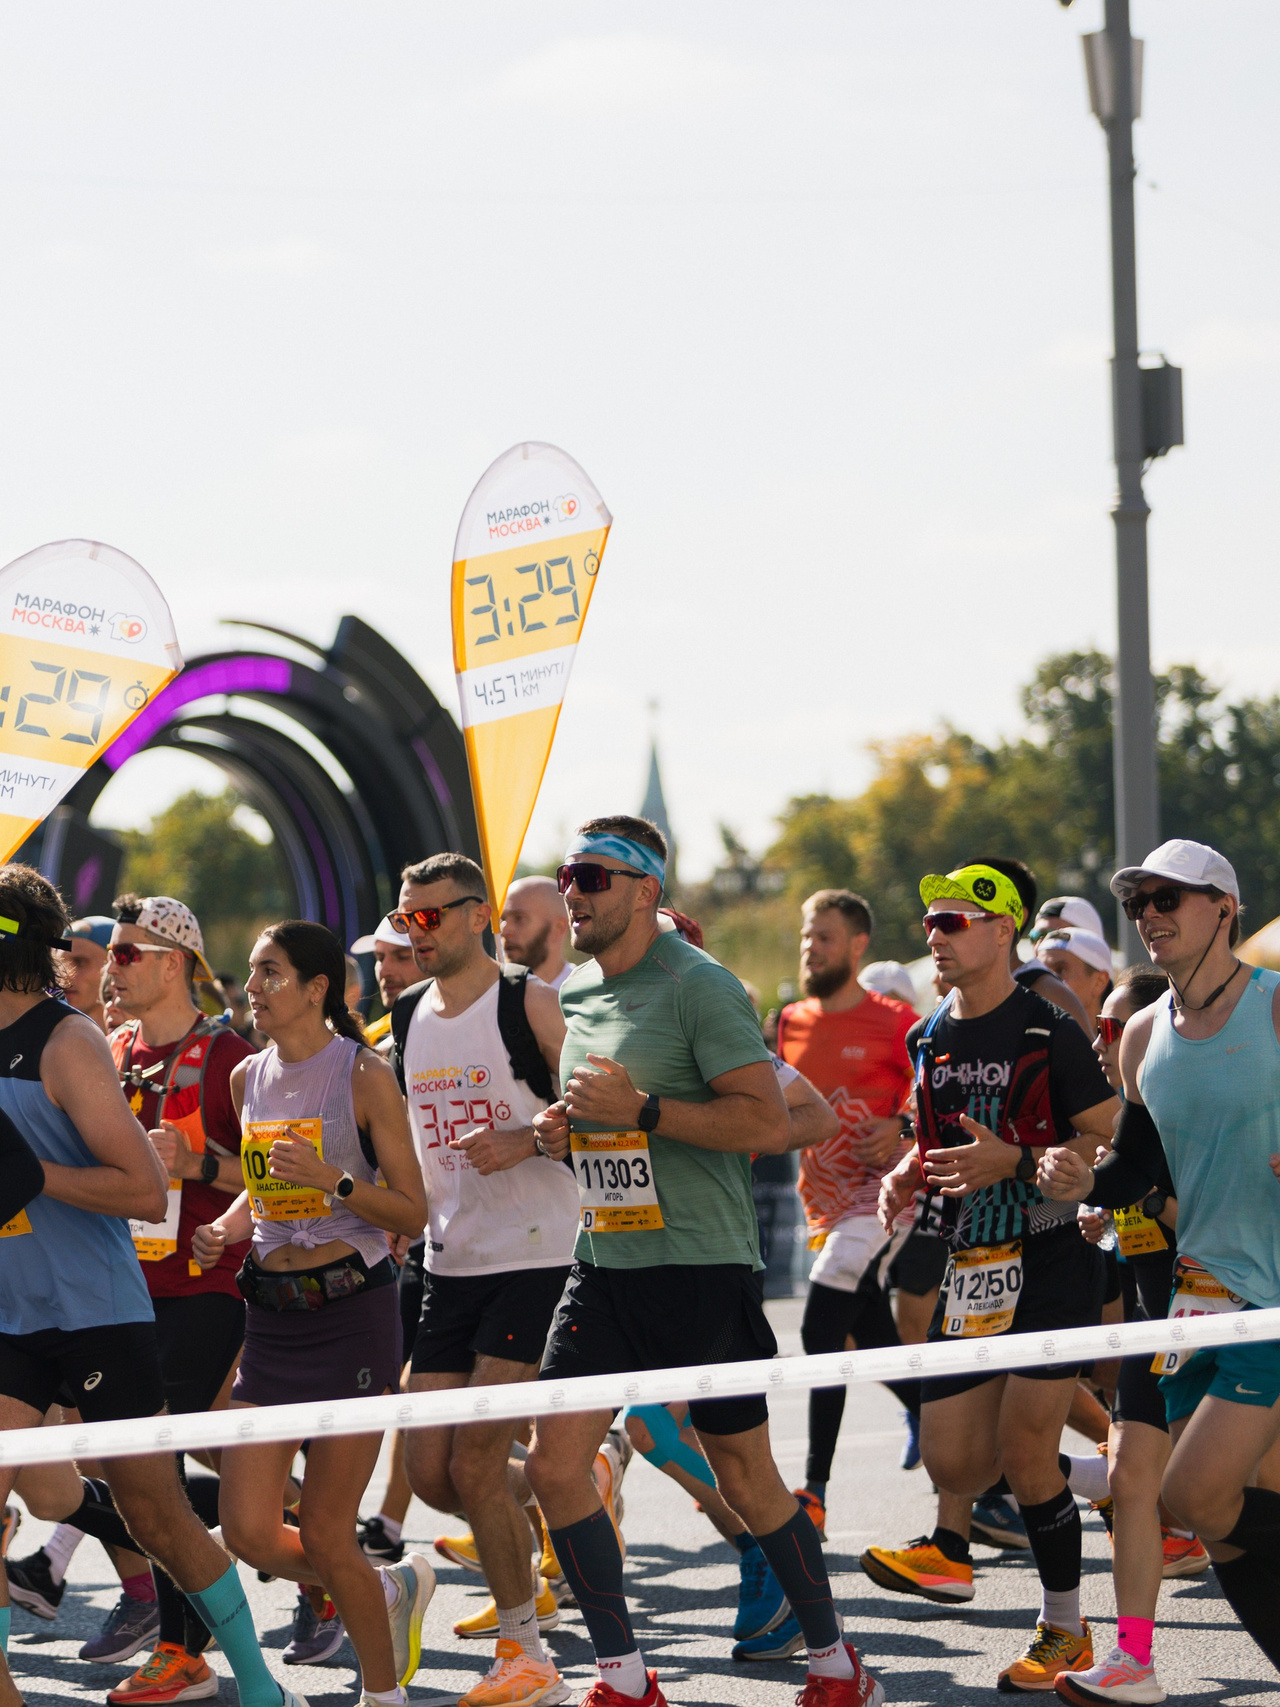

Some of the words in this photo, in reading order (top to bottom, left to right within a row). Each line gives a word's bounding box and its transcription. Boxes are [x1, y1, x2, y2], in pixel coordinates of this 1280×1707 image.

[487, 500, 551, 525] МАРАФОН
[489, 516, 541, 539] МОСКВА
[14, 592, 105, 622] МАРАФОН
[465, 555, 580, 646] 3:29
[12, 608, 86, 635] МОСКВА
[474, 674, 520, 706] 4:57
[522, 683, 540, 698] КМ
[412, 1066, 463, 1082] МАРАФОН
[413, 1079, 456, 1095] МОСКВА
[962, 1086, 1001, 1096] ЗАБЕГ
[419, 1099, 495, 1149] 3:29
[588, 1133, 616, 1141] МАРАФОН
[580, 1157, 650, 1189] 11303
[605, 1192, 624, 1202] ИГОРЬ
[584, 1211, 592, 1228] D
[130, 1224, 144, 1232] ТОН
[1195, 1285, 1220, 1294] МОСКВА
[951, 1318, 961, 1332] D
[1166, 1353, 1178, 1369] D
